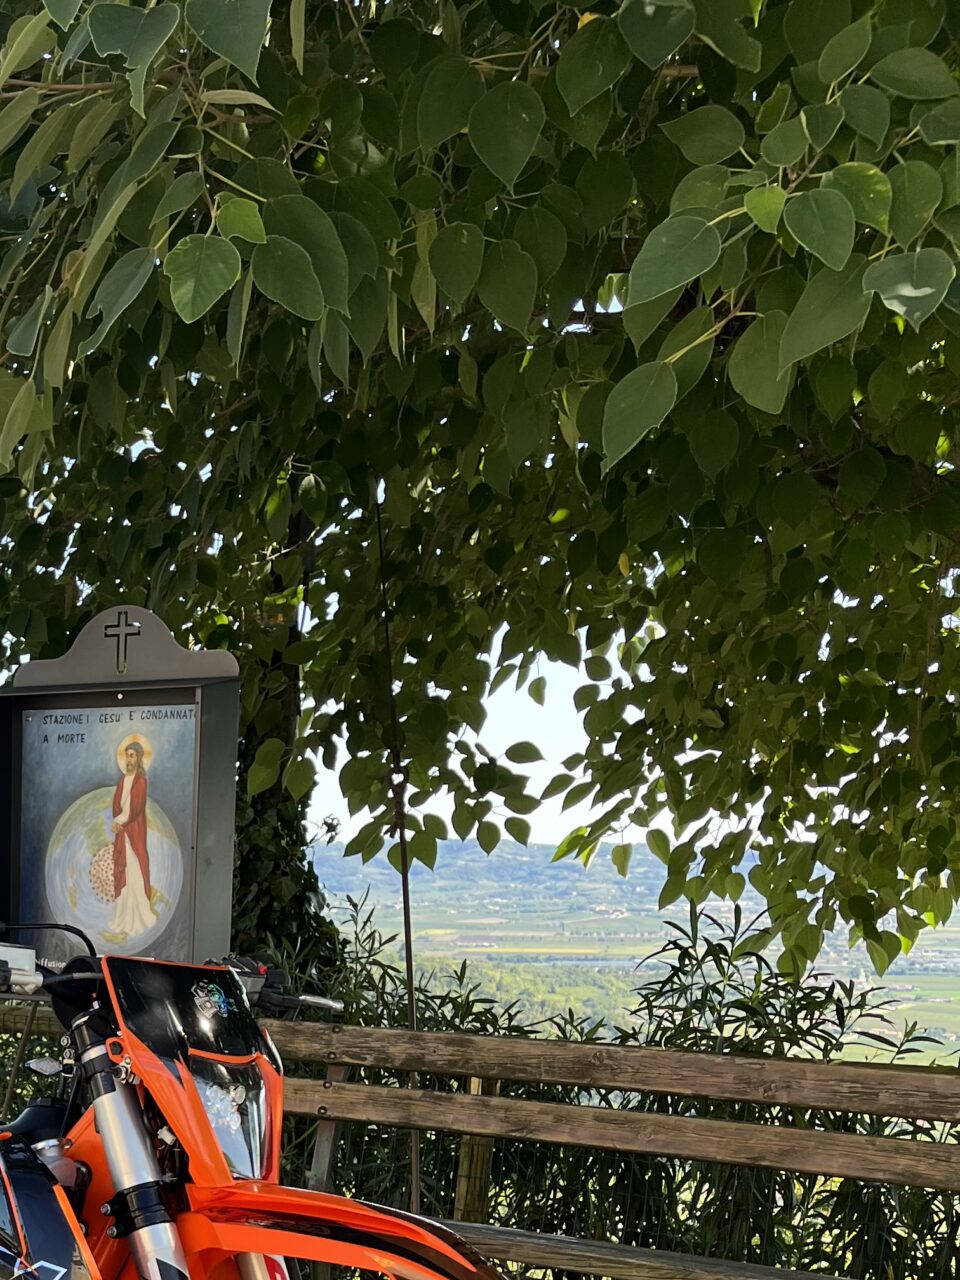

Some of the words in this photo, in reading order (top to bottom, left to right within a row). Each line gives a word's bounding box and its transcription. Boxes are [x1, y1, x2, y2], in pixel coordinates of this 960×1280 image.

[42, 714, 85, 725] STAZIONE
[42, 733, 49, 744] A
[57, 733, 86, 744] MORTE
